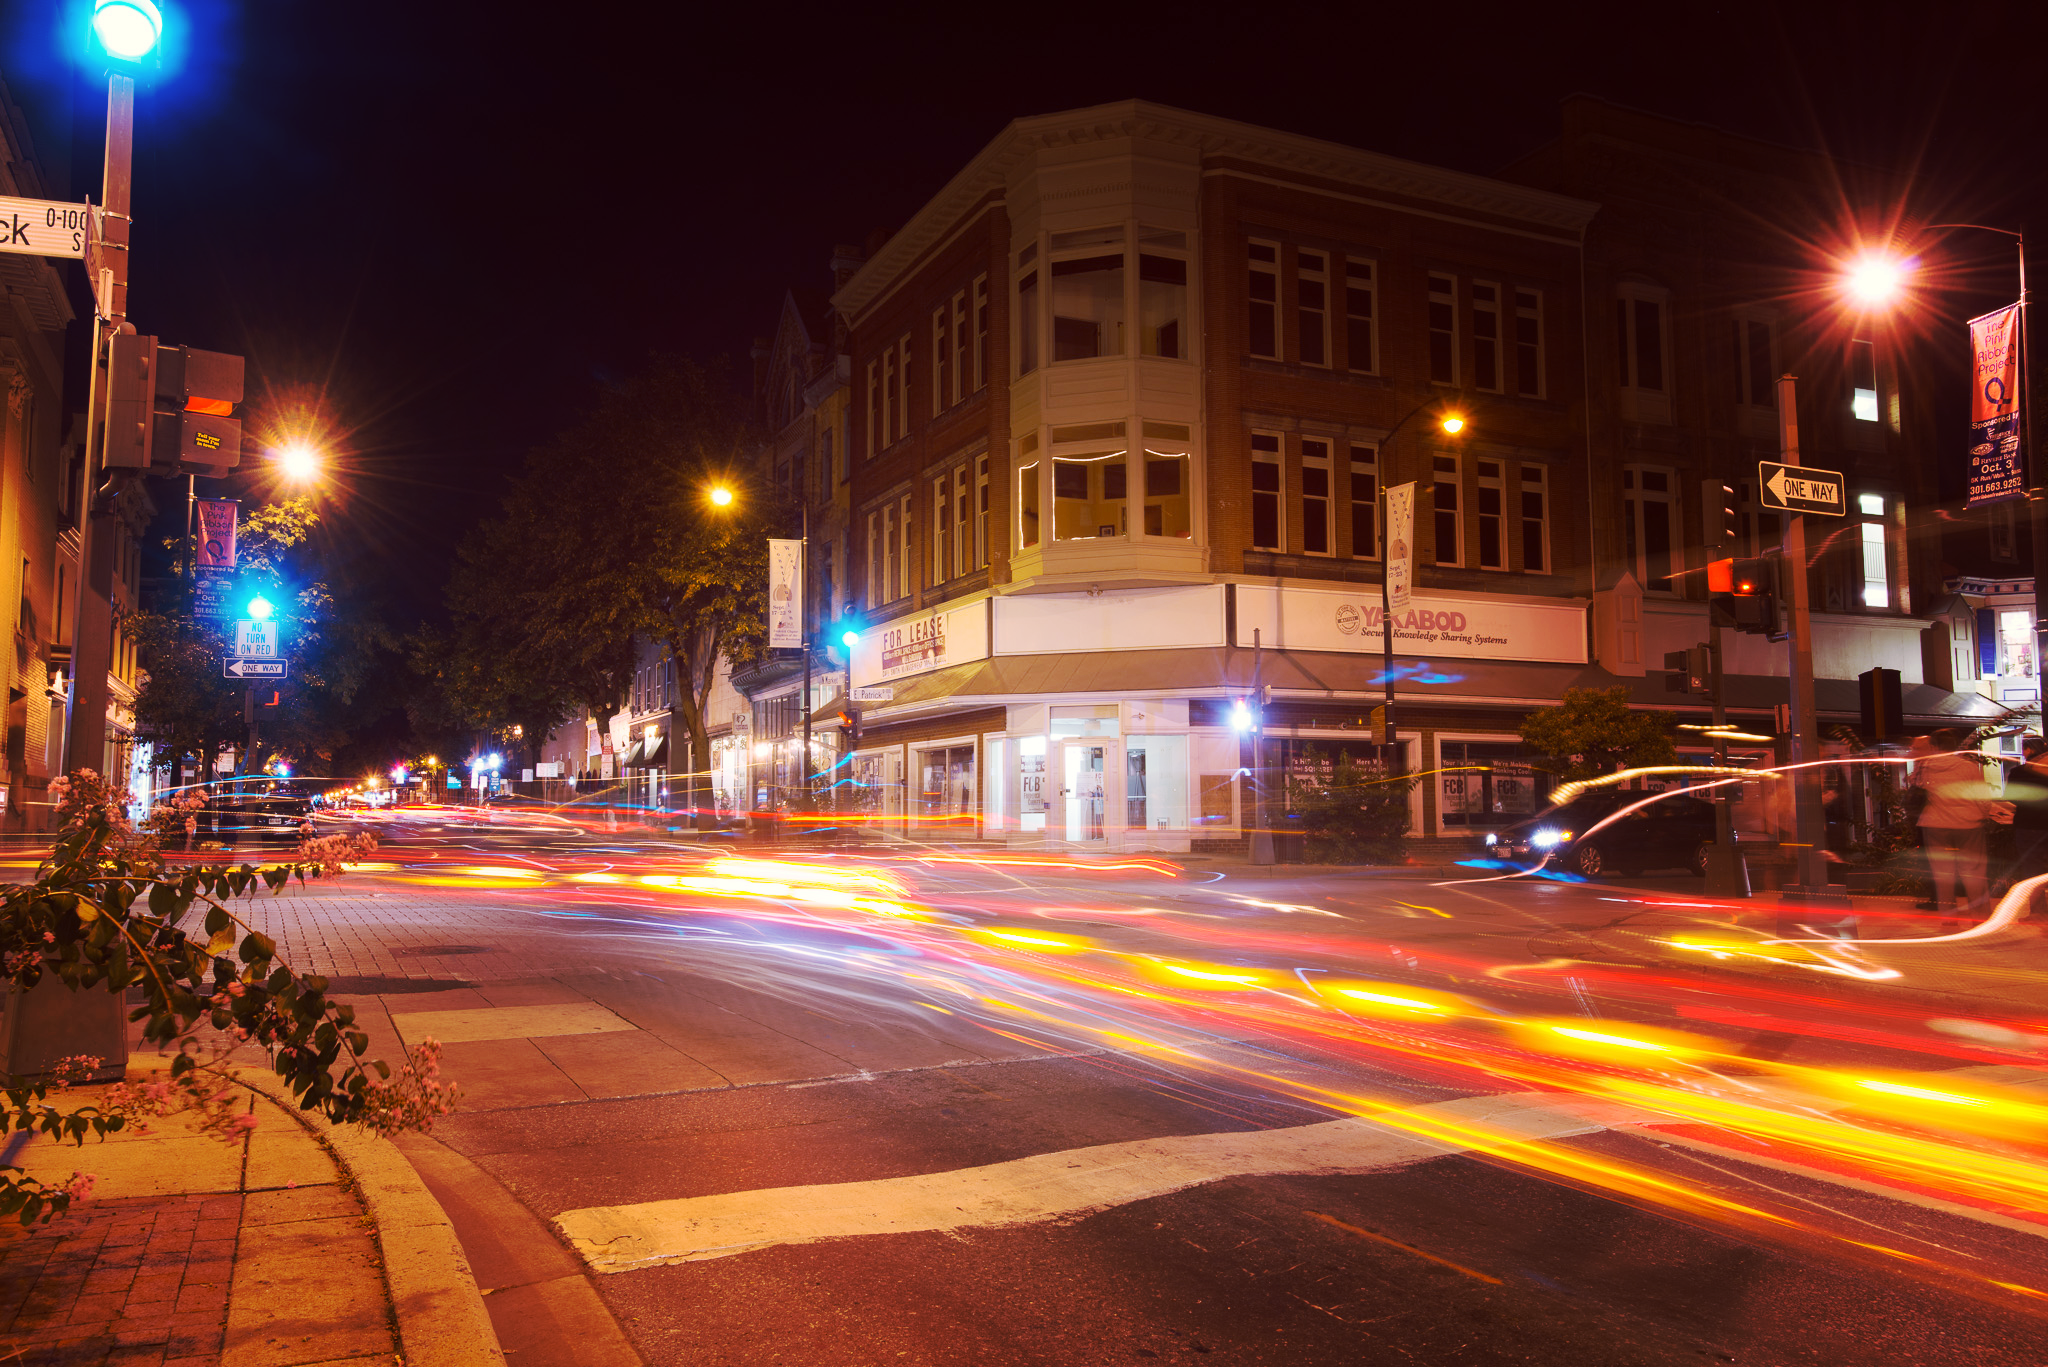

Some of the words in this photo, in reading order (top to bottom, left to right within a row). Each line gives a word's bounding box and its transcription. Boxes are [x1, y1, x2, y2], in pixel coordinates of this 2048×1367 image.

[1986, 320, 2004, 334] The
[1984, 331, 2006, 347] Pink
[1977, 343, 2015, 363] Ribbon
[1978, 355, 2015, 376] Project
[1971, 413, 2011, 430] Sponsored
[1981, 462, 2002, 474] Oct.
[2005, 459, 2013, 469] 3
[1784, 479, 1806, 498] ONE
[1811, 482, 1834, 501] WAY
[1970, 476, 2022, 495] 301.663.9252
[208, 502, 226, 512] The
[207, 511, 226, 520] Pink
[251, 622, 263, 633] NO
[883, 628, 902, 651] FOR
[910, 616, 942, 643] LEASE
[246, 633, 266, 644] TURN
[1361, 627, 1384, 637] Secur
[1393, 629, 1438, 643] Knowledge
[1441, 632, 1472, 645] Sharing
[1475, 634, 1508, 645] Systems
[241, 644, 251, 655] ON
[255, 644, 271, 655] RED
[241, 664, 259, 672] ONE
[262, 664, 280, 672] WAY
[861, 689, 882, 699] Patrick
[1492, 767, 1517, 775] Banking
[1024, 776, 1040, 792] FCB
[1443, 778, 1464, 795] FCB
[1497, 779, 1517, 795] FCB
